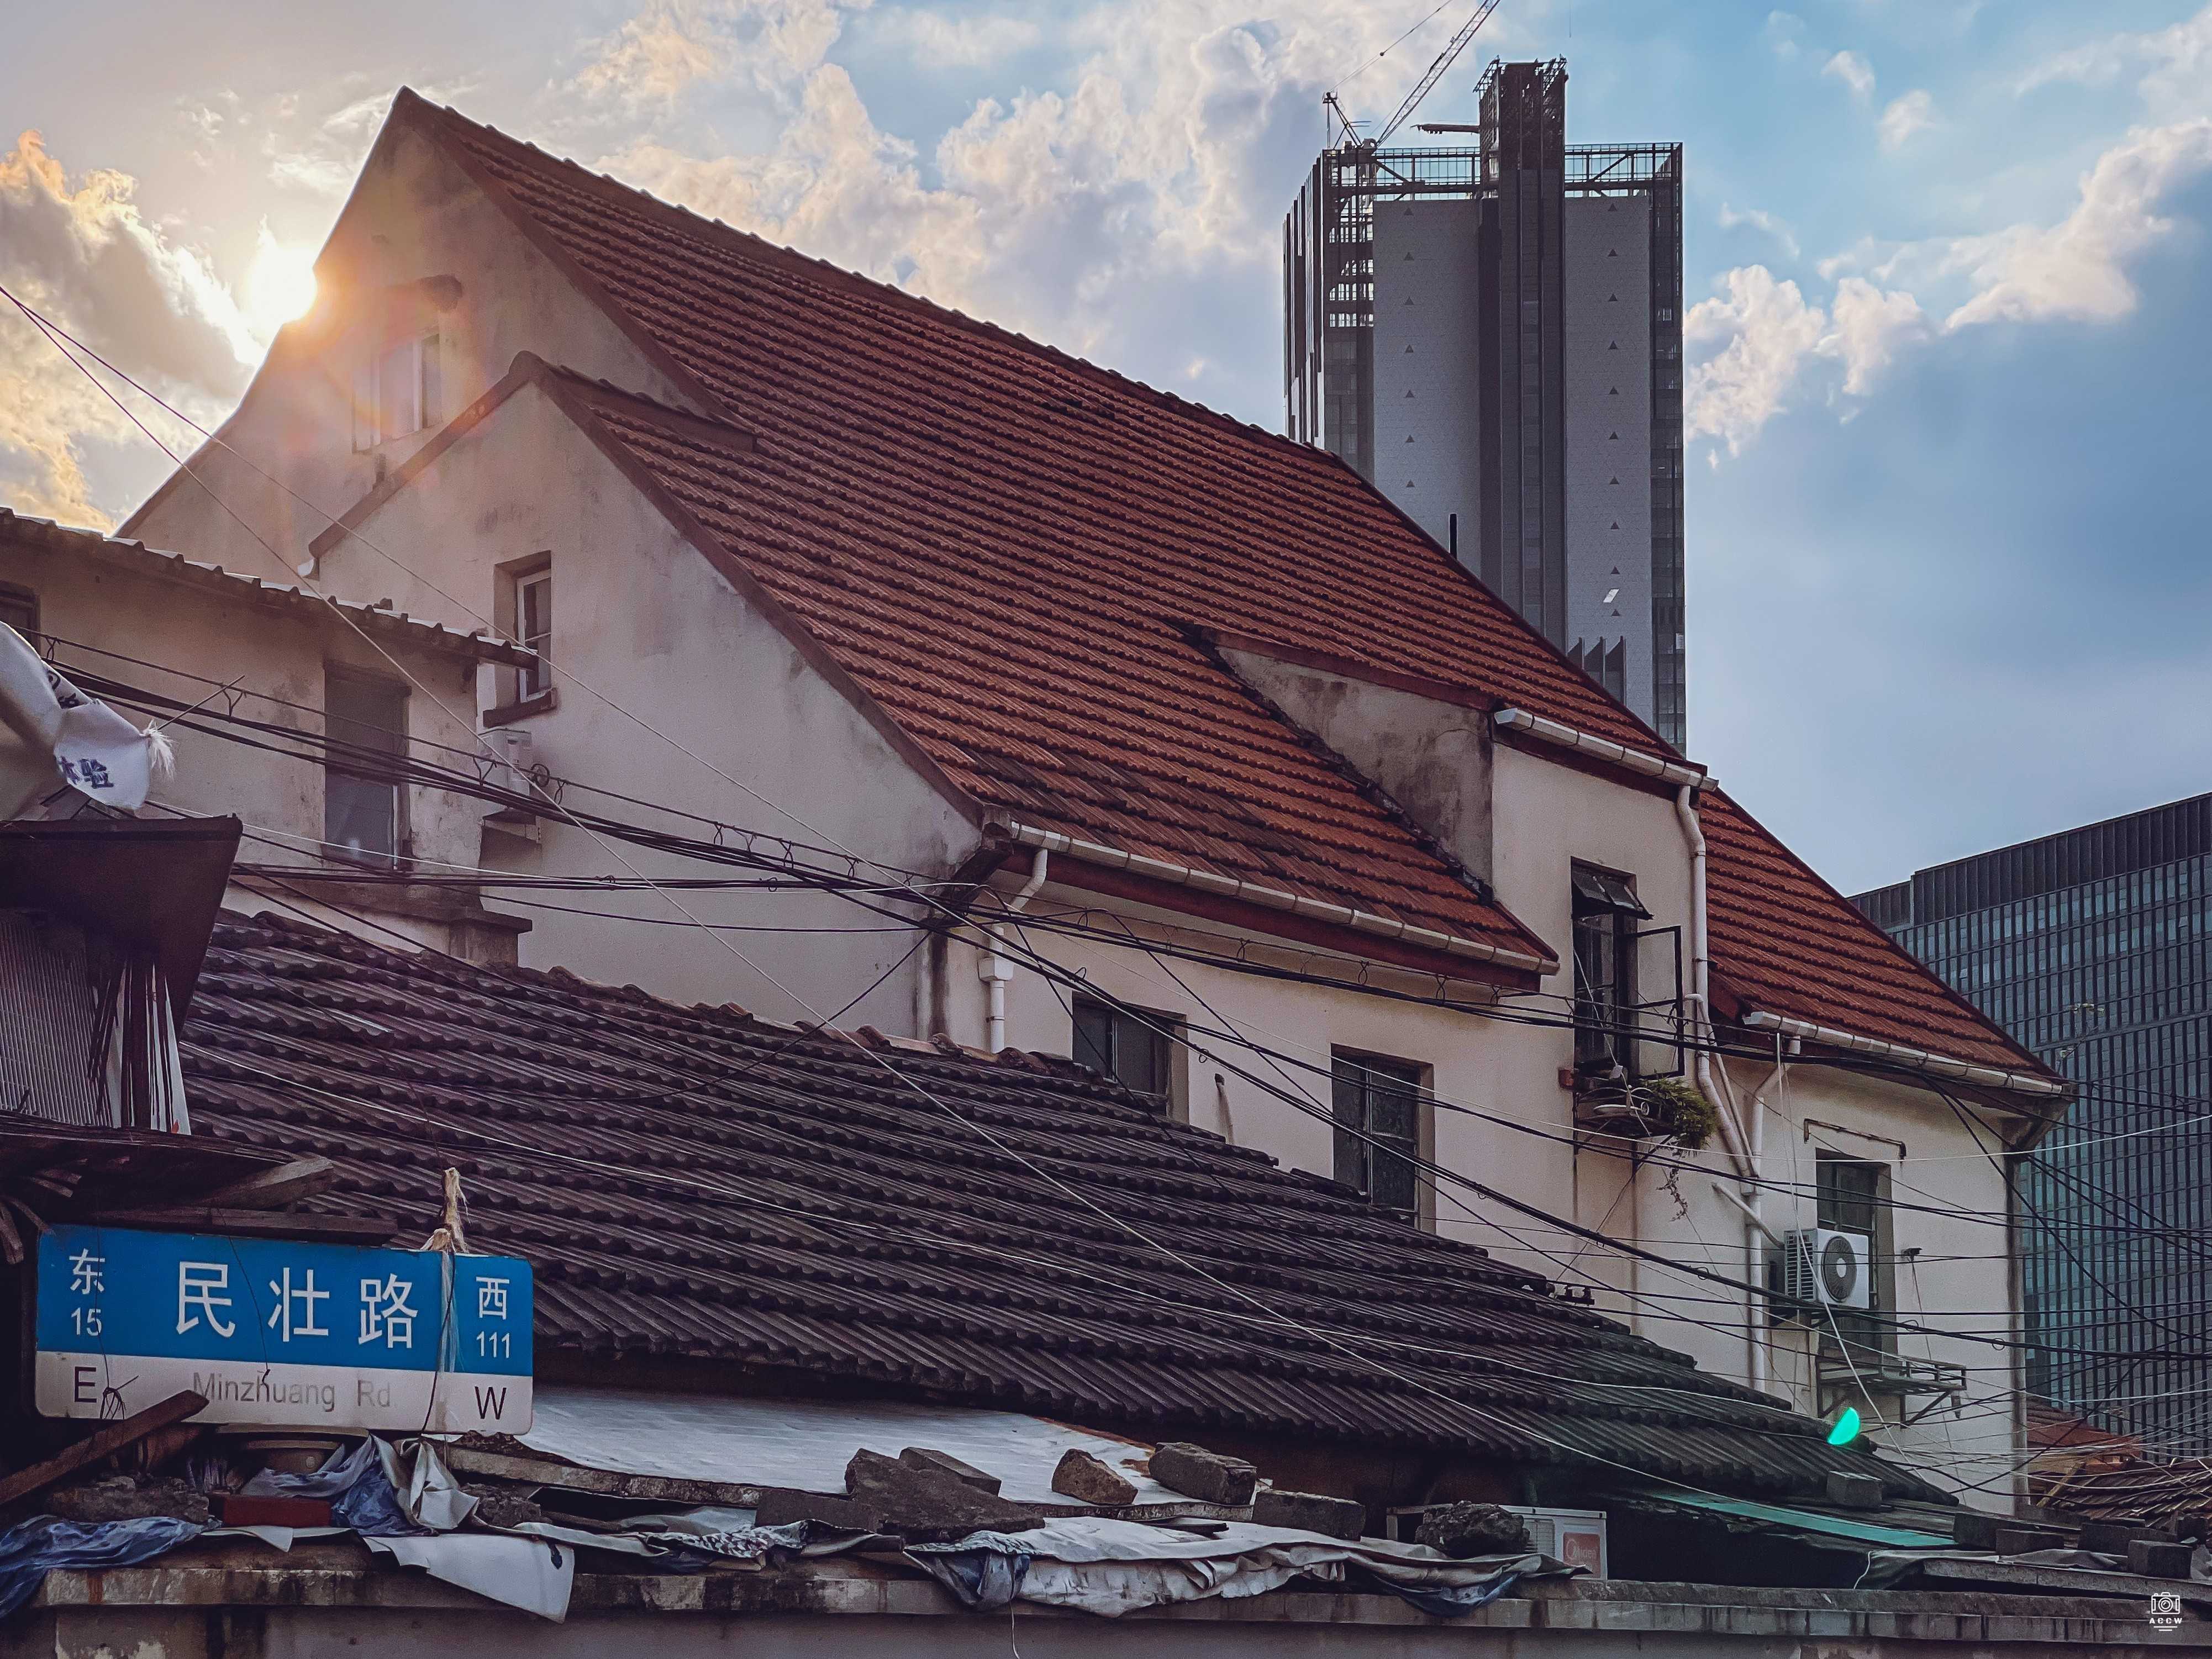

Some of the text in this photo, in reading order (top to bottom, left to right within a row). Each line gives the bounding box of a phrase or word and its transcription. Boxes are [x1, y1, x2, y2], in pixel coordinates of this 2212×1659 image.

[69, 1247, 106, 1295] 东
[175, 1260, 419, 1349] 民壮路
[475, 1276, 510, 1320] 西
[70, 1307, 102, 1337] 15
[476, 1330, 510, 1358] 111
[73, 1366, 97, 1404] E
[193, 1371, 391, 1413] Minzhuang Rd
[473, 1386, 507, 1420] W
